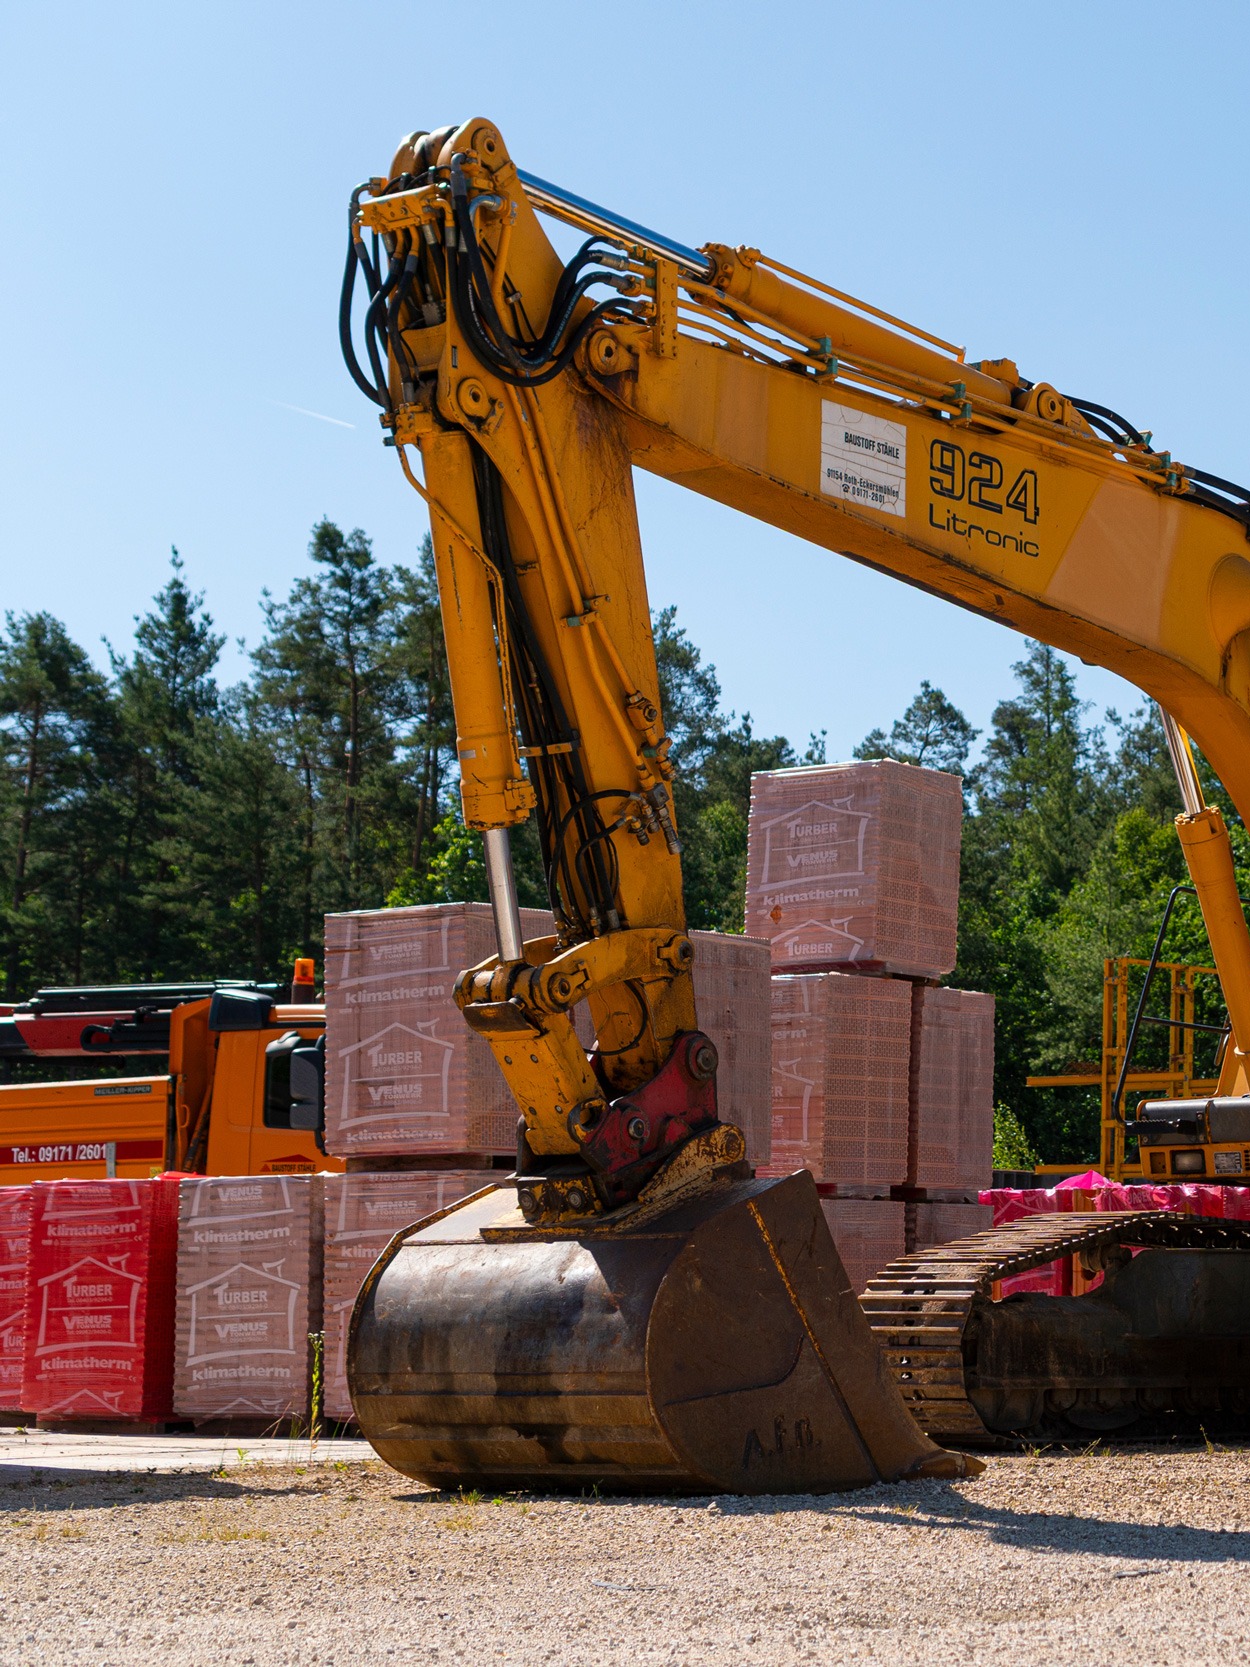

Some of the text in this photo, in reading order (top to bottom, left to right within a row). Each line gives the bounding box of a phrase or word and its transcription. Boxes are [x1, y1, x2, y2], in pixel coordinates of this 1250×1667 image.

[844, 431, 900, 459] BAUSTOFF STÄHLE
[826, 468, 843, 481] 91154
[929, 438, 1040, 525] 924
[929, 502, 1040, 557] Litronic
[786, 817, 838, 838] TURBER
[786, 849, 838, 867] VENUS
[763, 887, 859, 906] klimatherm
[370, 941, 422, 960] VENUS
[784, 936, 833, 956] TURBER
[345, 984, 445, 1004] klimatherm
[367, 1042, 422, 1068] TURBER
[368, 1083, 423, 1100] VENUS
[38, 1146, 73, 1162] 09171
[271, 1164, 297, 1172] BAUSTOFF
[217, 1185, 263, 1201] VENUS
[365, 1200, 418, 1215] VENUS
[47, 1222, 137, 1237] klimatherm
[193, 1226, 290, 1243] klimatherm
[63, 1275, 112, 1298] TURBER
[213, 1281, 268, 1305] TURBER
[62, 1314, 112, 1330] VENUS
[214, 1321, 268, 1338] VENUS
[0, 1326, 23, 1347] TUR
[41, 1357, 132, 1371] klimatherm
[192, 1365, 291, 1381] klimatherm
